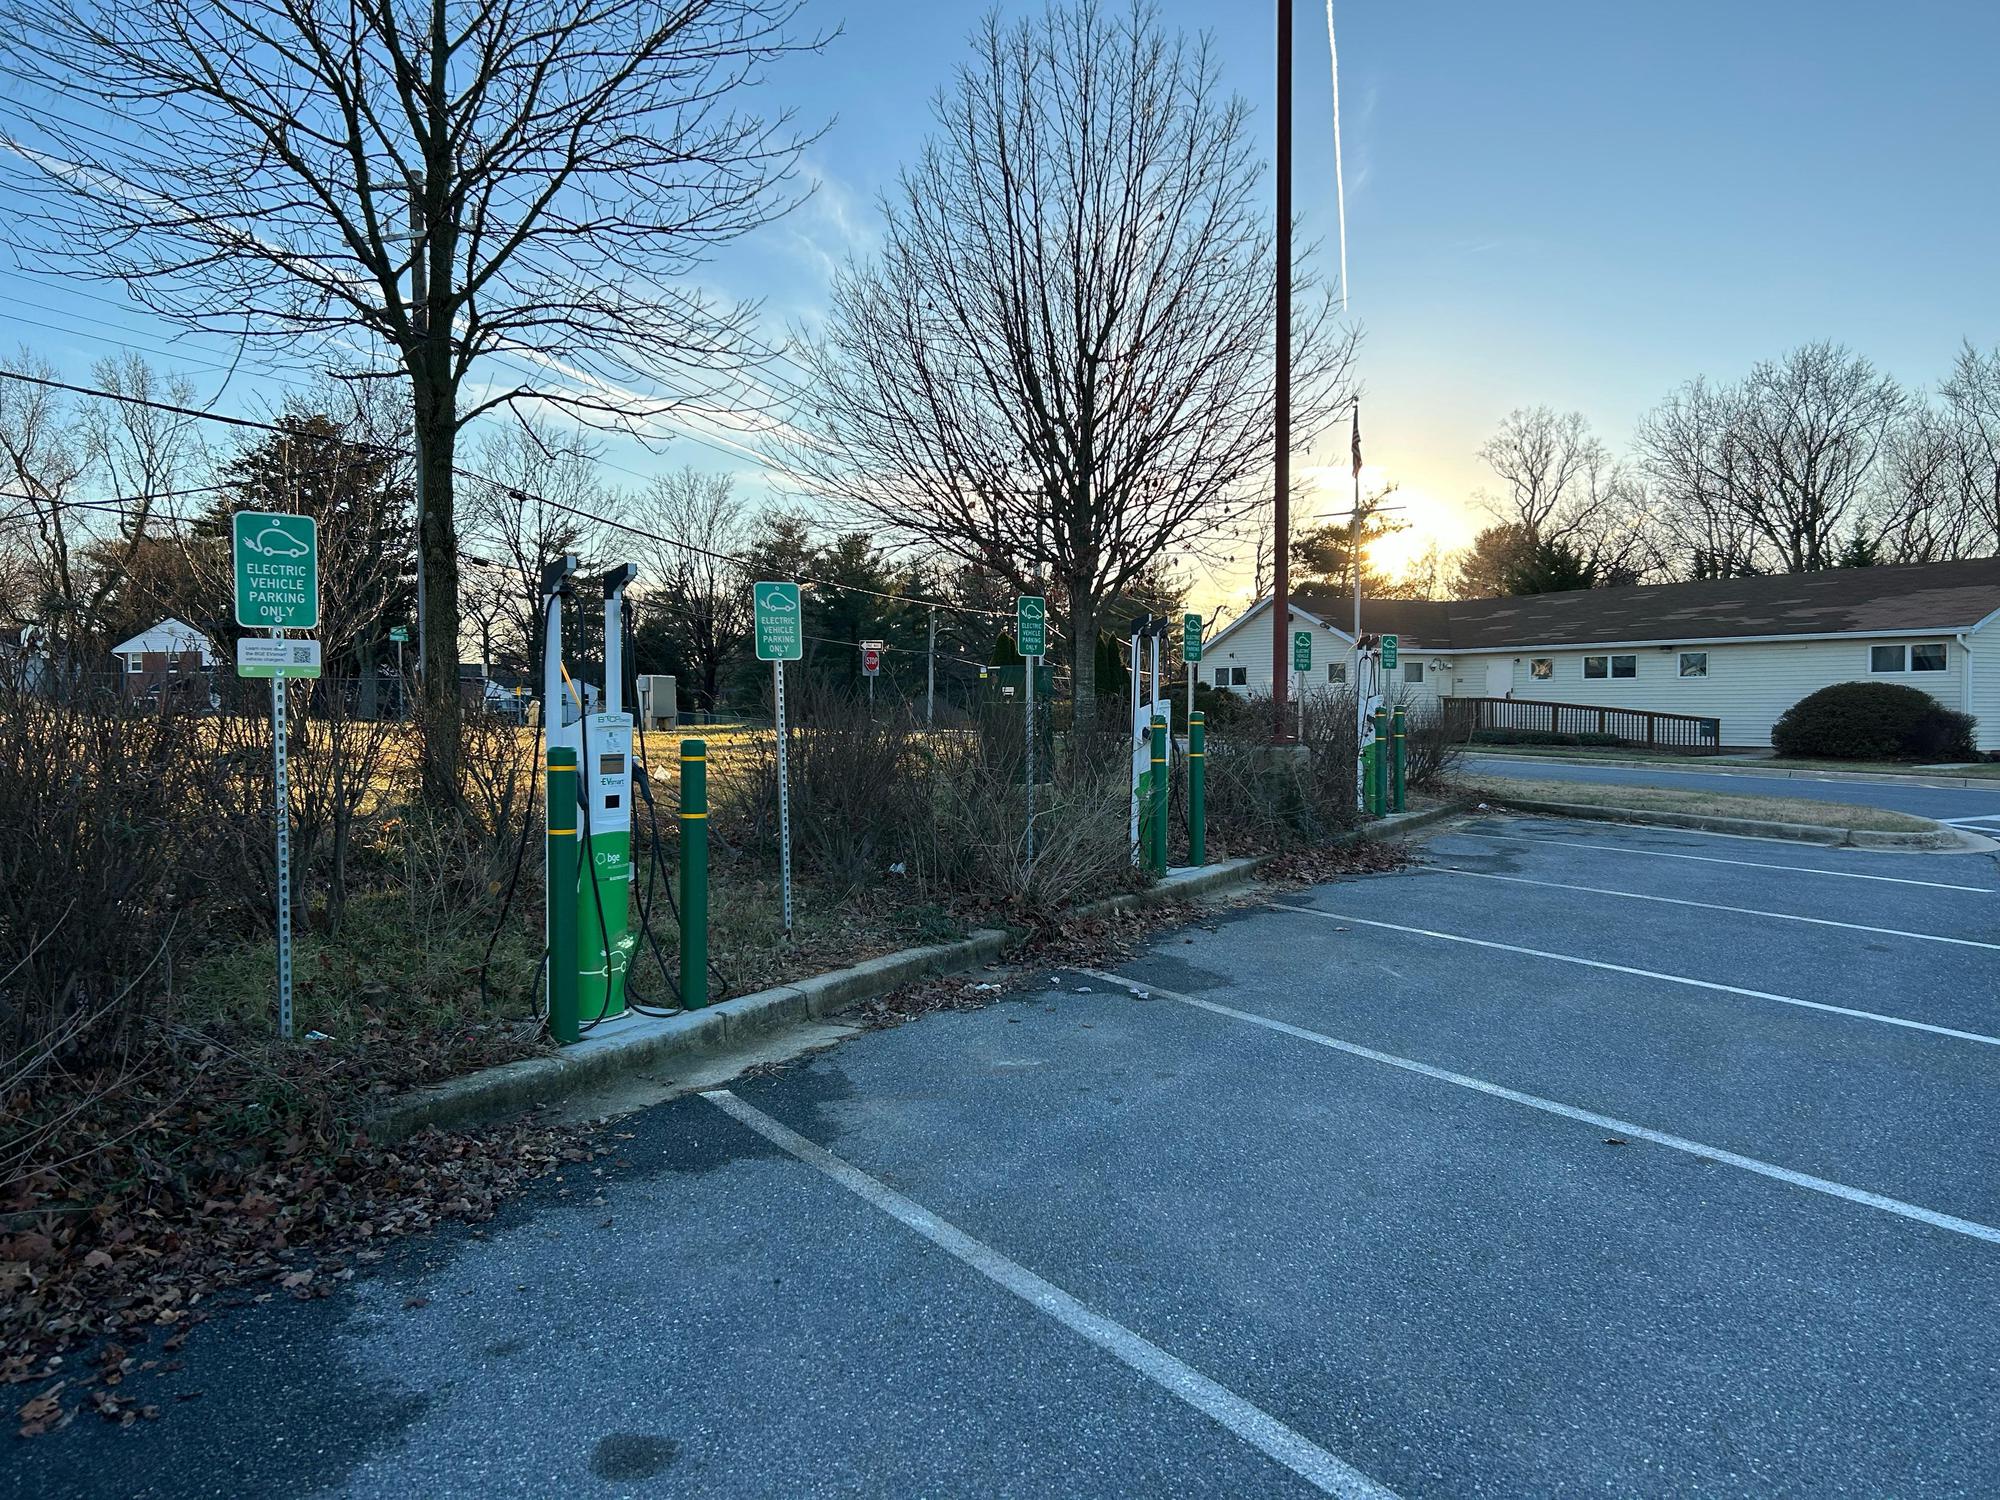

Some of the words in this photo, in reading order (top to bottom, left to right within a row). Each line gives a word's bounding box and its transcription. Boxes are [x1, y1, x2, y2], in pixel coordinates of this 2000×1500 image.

[247, 563, 307, 577] ELECTRIC
[250, 577, 305, 590] VEHICLE
[249, 591, 305, 604] PARKING
[260, 605, 295, 617] ONLY
[761, 616, 795, 625] ELECTRIC
[763, 626, 794, 634] VEHICLE
[763, 635, 795, 643] PARKING
[769, 645, 789, 653] ONLY
[866, 656, 879, 665] STOP
[600, 777, 625, 786] EVsmart
[607, 852, 620, 864] bge
